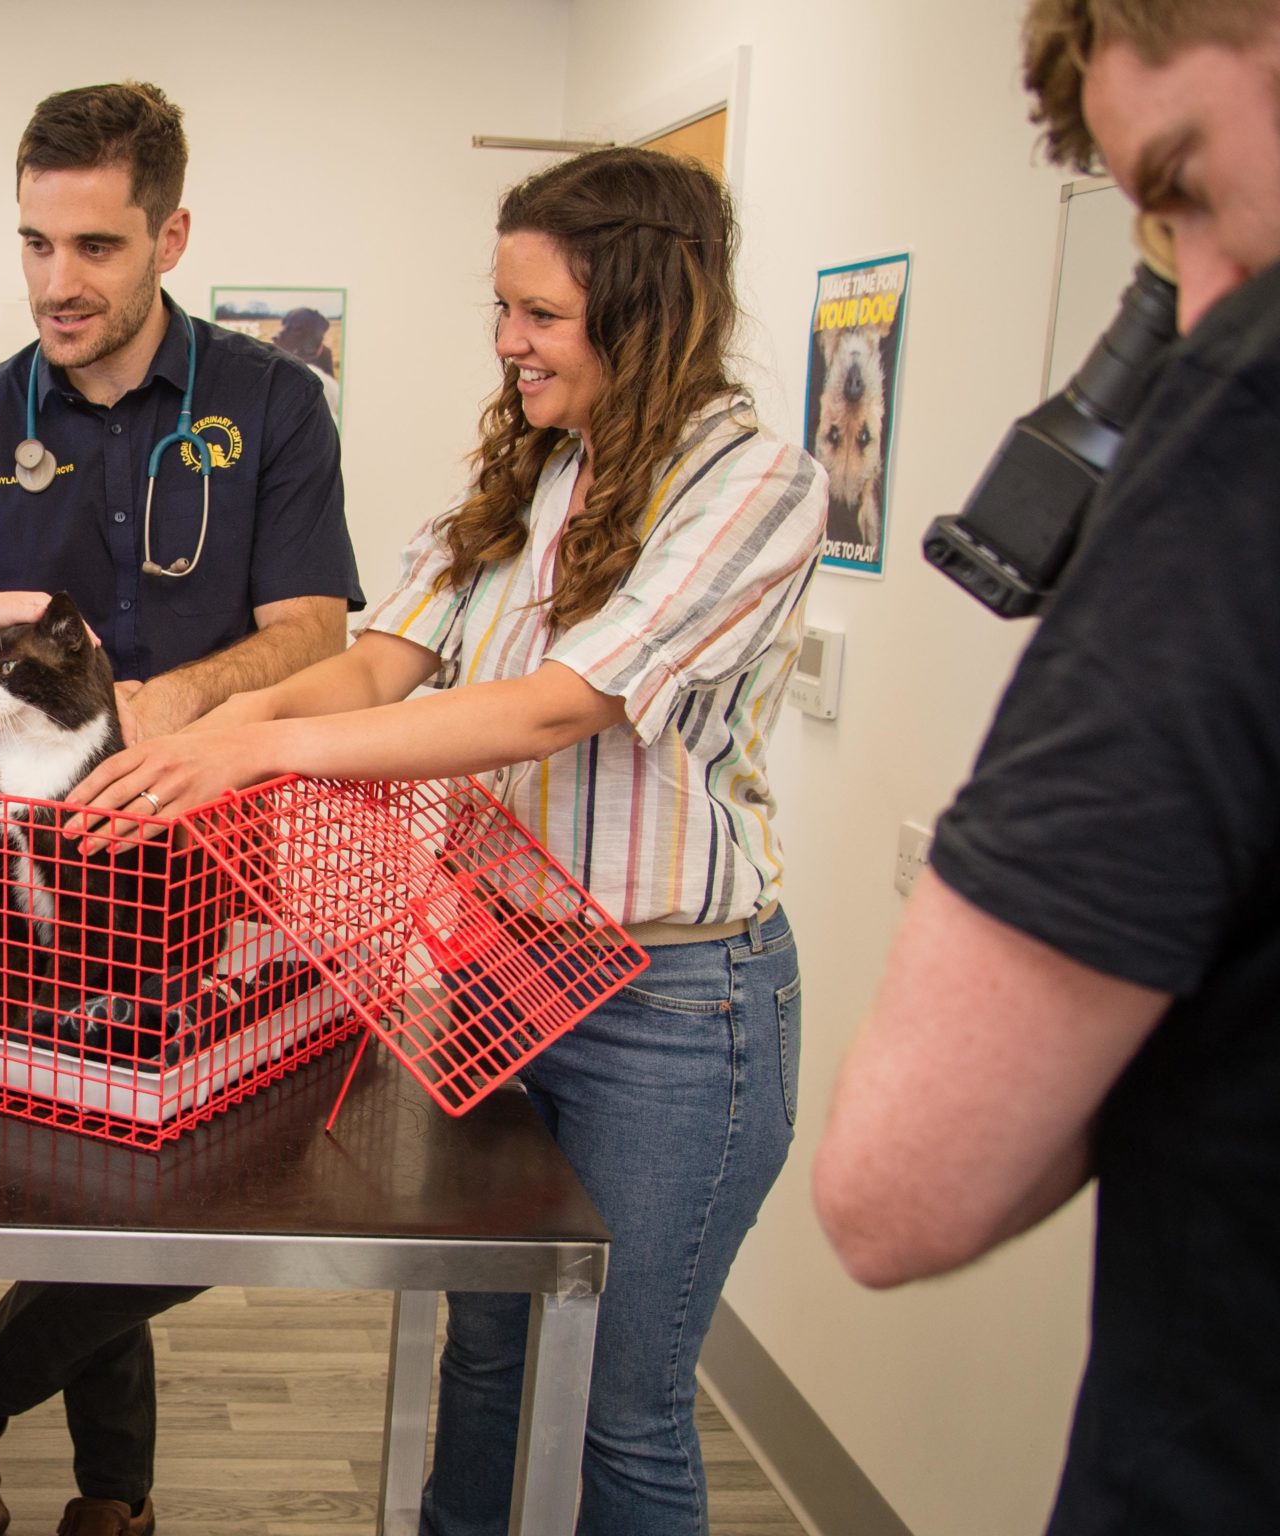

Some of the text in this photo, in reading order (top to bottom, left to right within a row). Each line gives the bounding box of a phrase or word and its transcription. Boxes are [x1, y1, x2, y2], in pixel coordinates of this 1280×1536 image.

[822, 270, 898, 300] MAKE TIME FOR
[819, 294, 896, 330] YOUR DOG
[191, 416, 232, 433] ETERINARY
[230, 426, 242, 460] CENTRE
[824, 540, 875, 563] OVE TO PLAY
